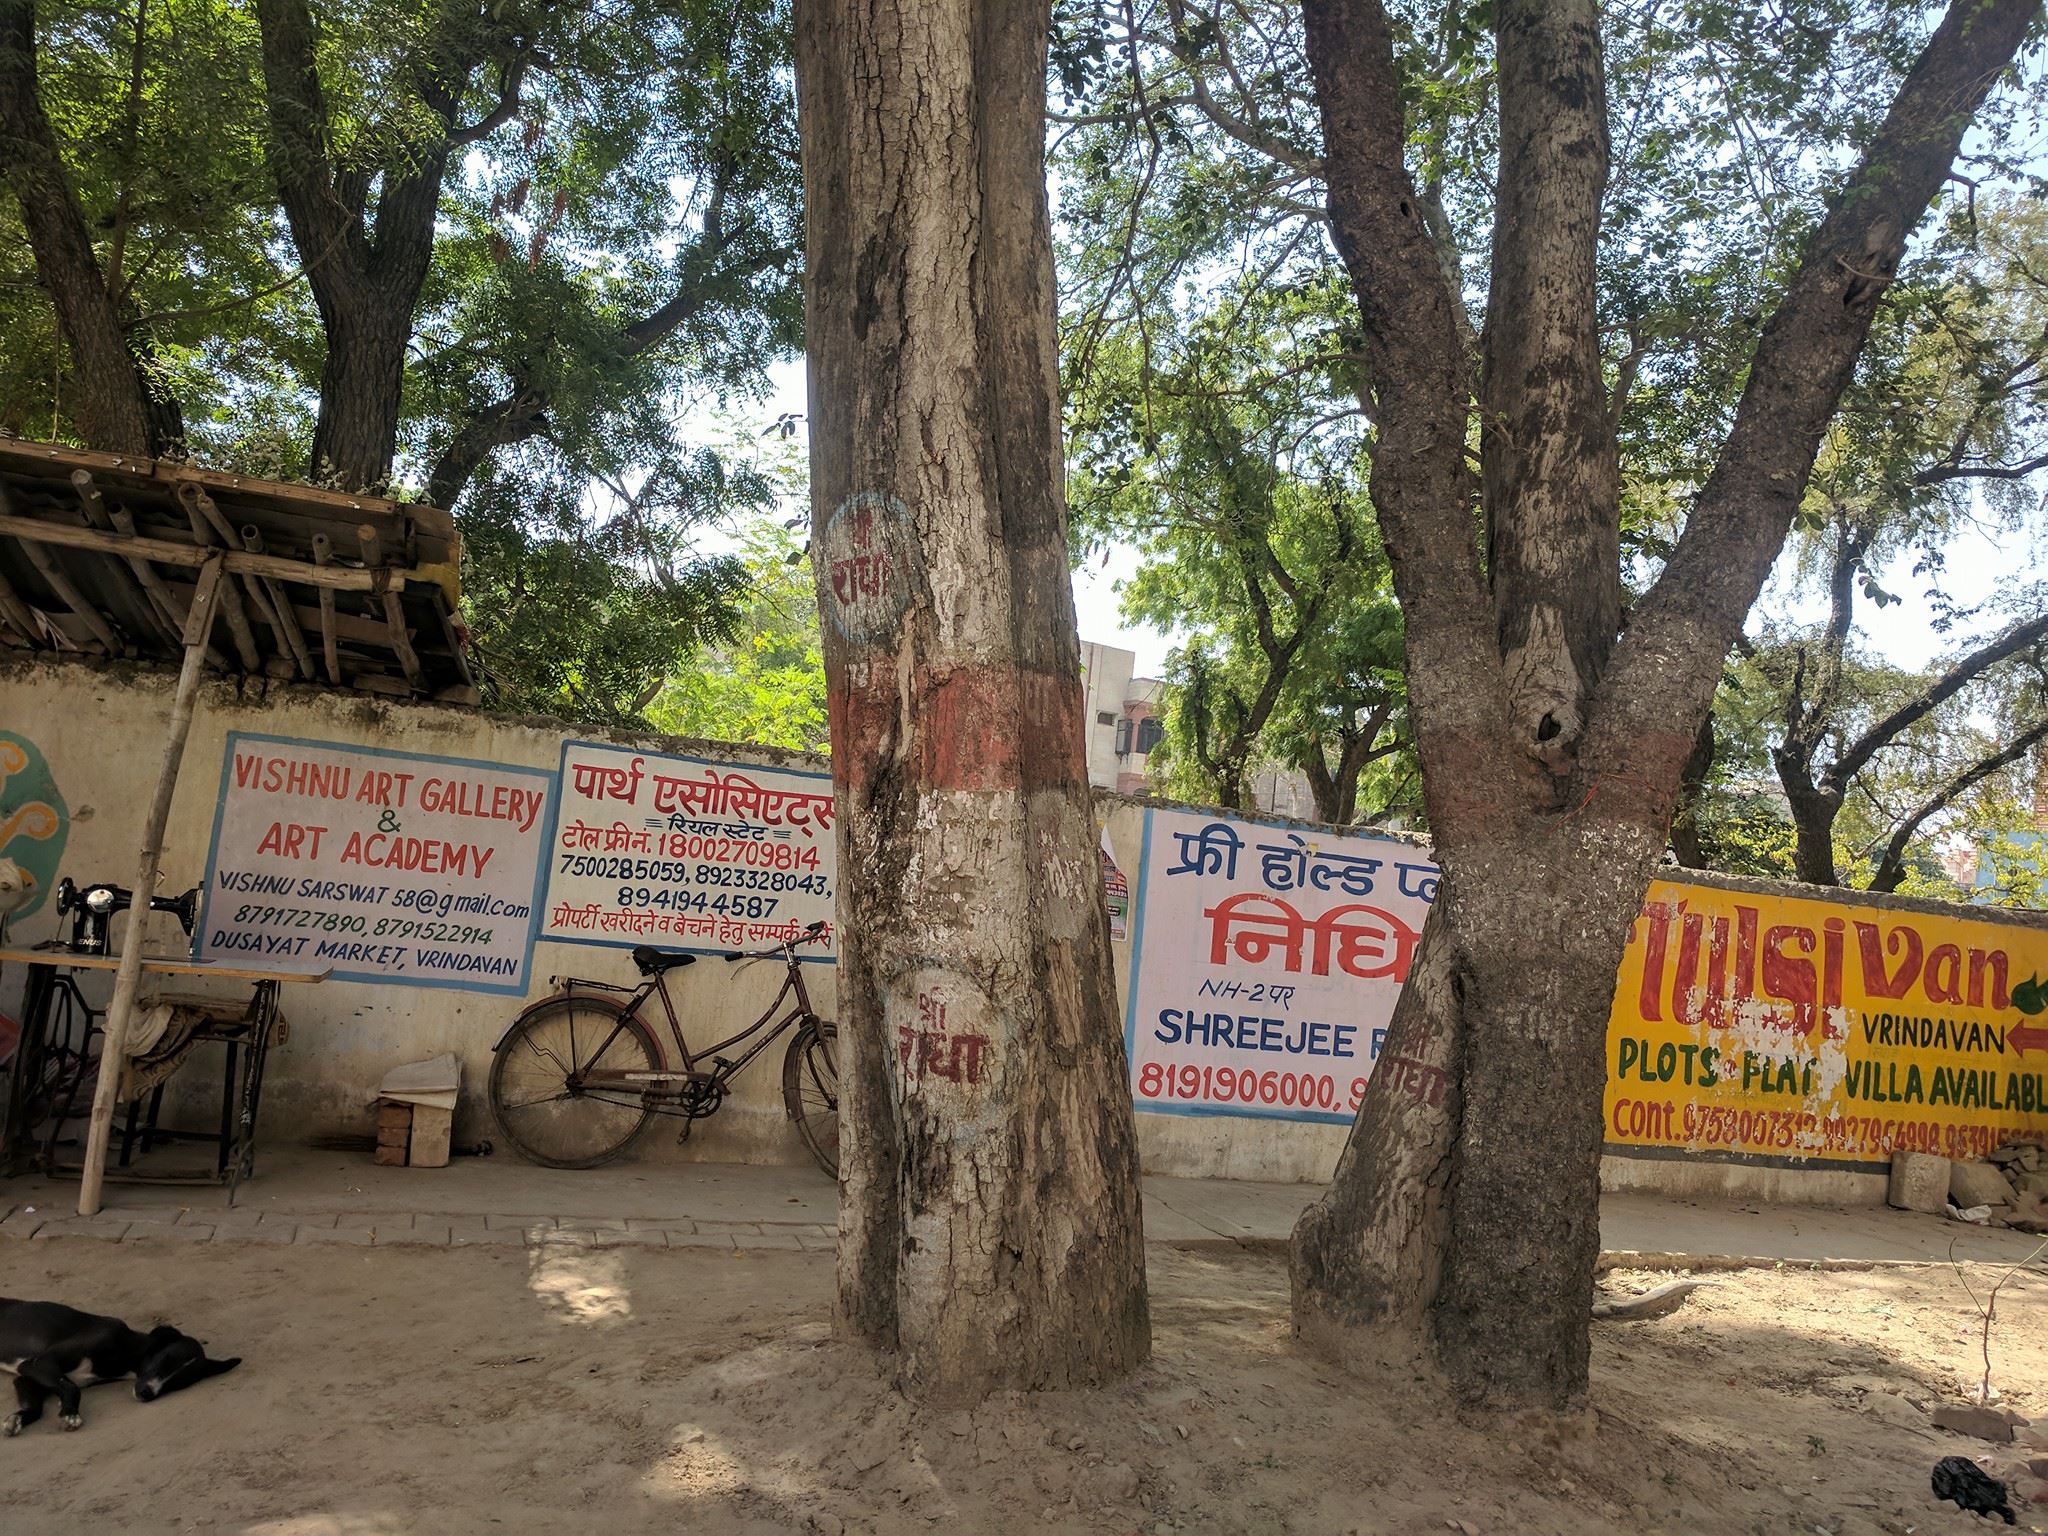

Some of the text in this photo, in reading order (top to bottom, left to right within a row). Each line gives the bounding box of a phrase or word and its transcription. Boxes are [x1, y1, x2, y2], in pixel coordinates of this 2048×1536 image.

[236, 754, 543, 833] VISHNU ART GALLERY
[572, 758, 645, 805] पार्थ
[377, 809, 401, 832] &
[667, 814, 768, 841] रियल स्टेट
[257, 822, 494, 879] ART ACADEMY
[562, 819, 603, 851] टोल
[603, 821, 633, 852] फ्री
[658, 833, 820, 872] 18002709814
[1166, 823, 1245, 880] फ्री
[1256, 834, 1383, 896] होल्ड
[219, 871, 295, 896] VISHNU
[297, 879, 389, 904] SARSWAT
[560, 854, 833, 900] 7500285059, 8923328043,
[234, 905, 493, 945] 8791727890, 8791522914
[550, 902, 601, 931] प्रोपर्टी
[600, 907, 659, 936] खरीदने
[659, 916, 675, 933] व
[673, 912, 722, 939] बेचने
[719, 917, 747, 945] हेतु
[617, 887, 779, 918] 8941944587
[211, 930, 518, 976] DUSAYAT MARKET, VRINDAVAN
[1853, 920, 2012, 1010] Van
[1198, 978, 1296, 1010] NH-2 पर
[1154, 1009, 1357, 1058] SHREEJEE
[1862, 1013, 2005, 1054] VRINDAVAN
[1138, 1062, 1341, 1112] 8191906000,
[1618, 1038, 1720, 1087] PLOTS
[1845, 1056, 1923, 1104] VILLA
